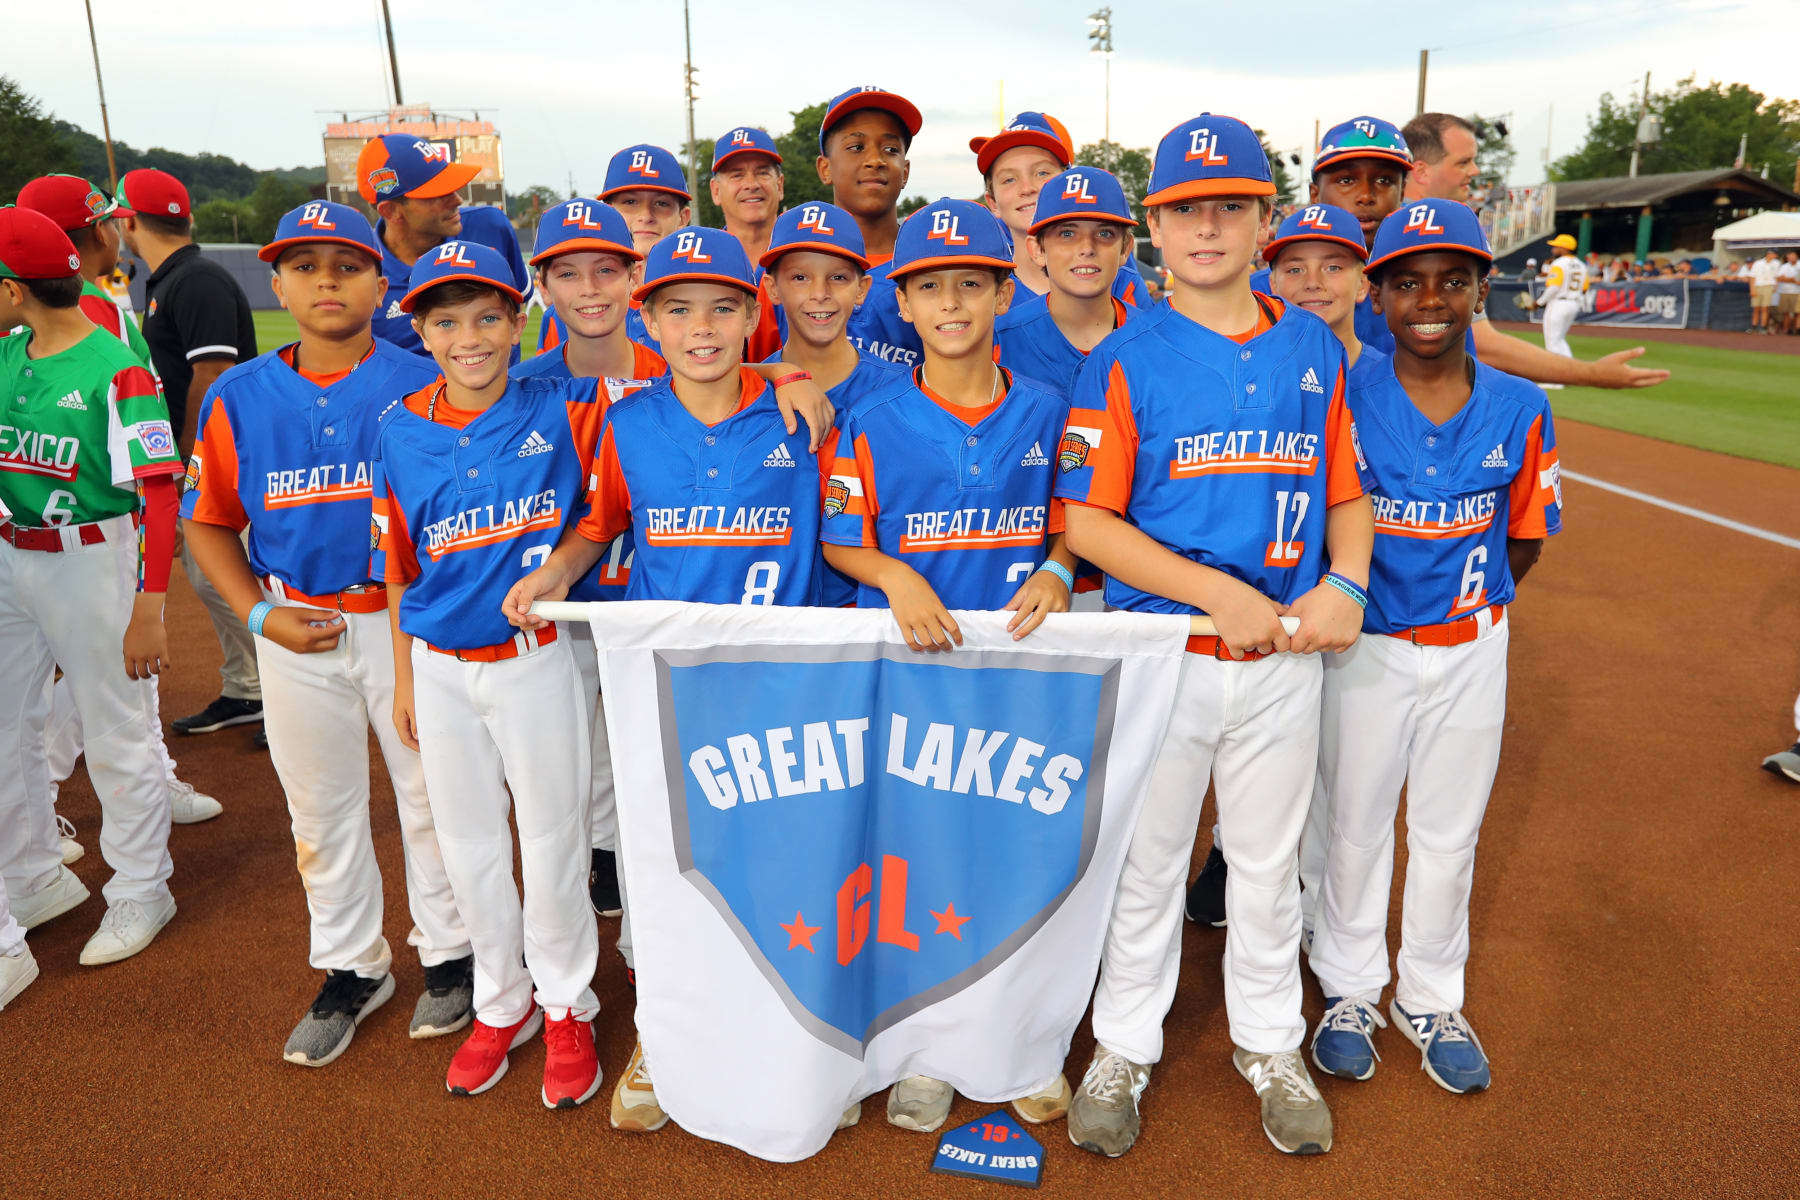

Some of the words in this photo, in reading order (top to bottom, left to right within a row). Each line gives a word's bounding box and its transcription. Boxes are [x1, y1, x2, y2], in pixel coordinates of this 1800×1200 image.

[732, 128, 754, 145] GL
[1189, 128, 1224, 161] GL
[631, 150, 658, 174] GL
[1065, 173, 1094, 200] GL
[302, 202, 333, 227] GL
[566, 201, 599, 227] GL
[802, 205, 831, 232] GL
[931, 209, 965, 241] GL
[1302, 205, 1330, 227] GL
[1409, 204, 1441, 231] GL
[438, 241, 471, 264] GL
[676, 231, 708, 259] GL
[1299, 381, 1324, 394] adidas
[56, 399, 88, 411] adidas
[517, 442, 554, 459] adidas
[1174, 430, 1253, 465] GREAT
[1258, 430, 1319, 461] LAKES
[763, 458, 796, 468] adidas
[1020, 456, 1049, 467] adidas
[1481, 458, 1509, 469] adidas
[266, 464, 335, 498] GREAT
[41, 489, 78, 527] 6
[423, 507, 482, 550] GREAT
[486, 488, 556, 531] LAKES
[646, 505, 713, 535] GREAT
[716, 505, 792, 534] LAKES
[1438, 491, 1497, 528] LAKES
[904, 509, 977, 541] GREAT
[981, 505, 1047, 536] LAKES
[1270, 490, 1311, 560] 12
[740, 561, 781, 605] 8
[1456, 544, 1489, 609] 6
[688, 715, 870, 812] GREAT
[885, 711, 1083, 816] LAKES
[835, 853, 921, 968] GL
[981, 1123, 1009, 1143] GL
[939, 1143, 987, 1166] LAKES
[989, 1155, 1038, 1169] GREAT
